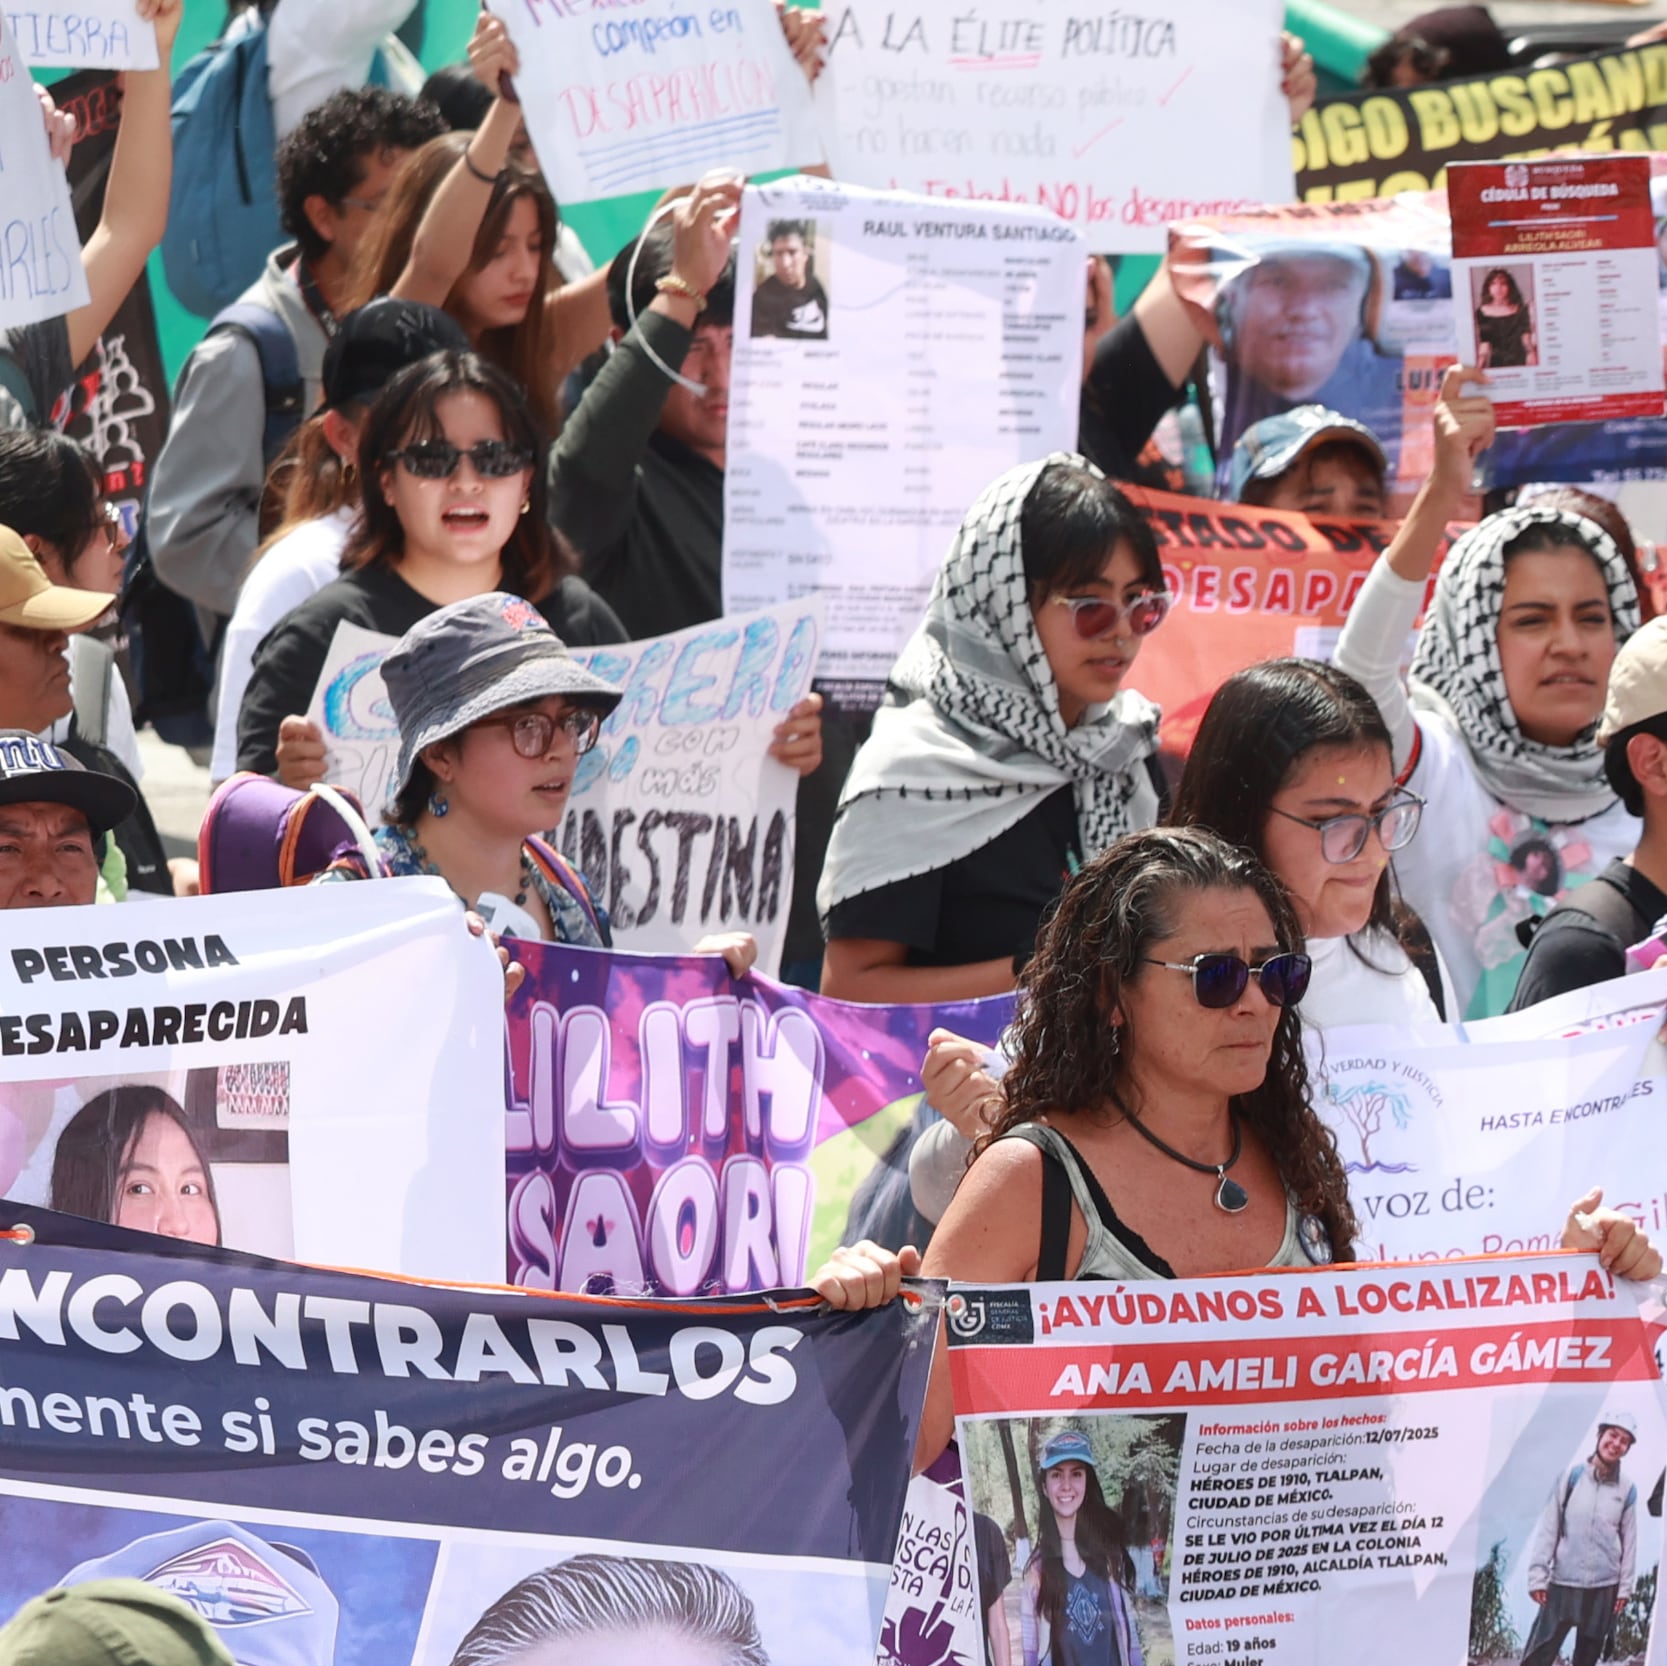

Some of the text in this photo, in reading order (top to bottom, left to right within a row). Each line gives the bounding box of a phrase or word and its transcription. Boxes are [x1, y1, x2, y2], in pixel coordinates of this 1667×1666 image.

[829, 5, 1178, 59] A LA ÉLITE POLÍTICA
[1532, 184, 1549, 201] DE
[863, 219, 1078, 243] RAUL VENTURA SANTIAGO
[10, 933, 241, 985] PERSONA
[0, 995, 309, 1056] ESAPARECIDA
[1330, 1056, 1388, 1075] VERDAD
[1402, 1064, 1445, 1109] JUSTICIA
[1479, 1110, 1544, 1133] HASTA
[1362, 1177, 1495, 1221] voz de:
[509, 1153, 818, 1298] SAORI
[1039, 1269, 1617, 1336] ¡AYÚDANOS A LOCALIZARLA!
[0, 1267, 803, 1404] NCONTRARLOS
[1050, 1334, 1614, 1399] ANA AMELI GARCÍA GÁMEZ
[220, 1396, 643, 1500] si sabes algo.
[1199, 1413, 1387, 1437] Información sobre los hechos:
[1188, 1486, 1334, 1511] CIUDAD DE MÉXICO.
[1185, 1611, 1296, 1632] Datos personales:
[1187, 1636, 1277, 1657] Edad: 19 años
